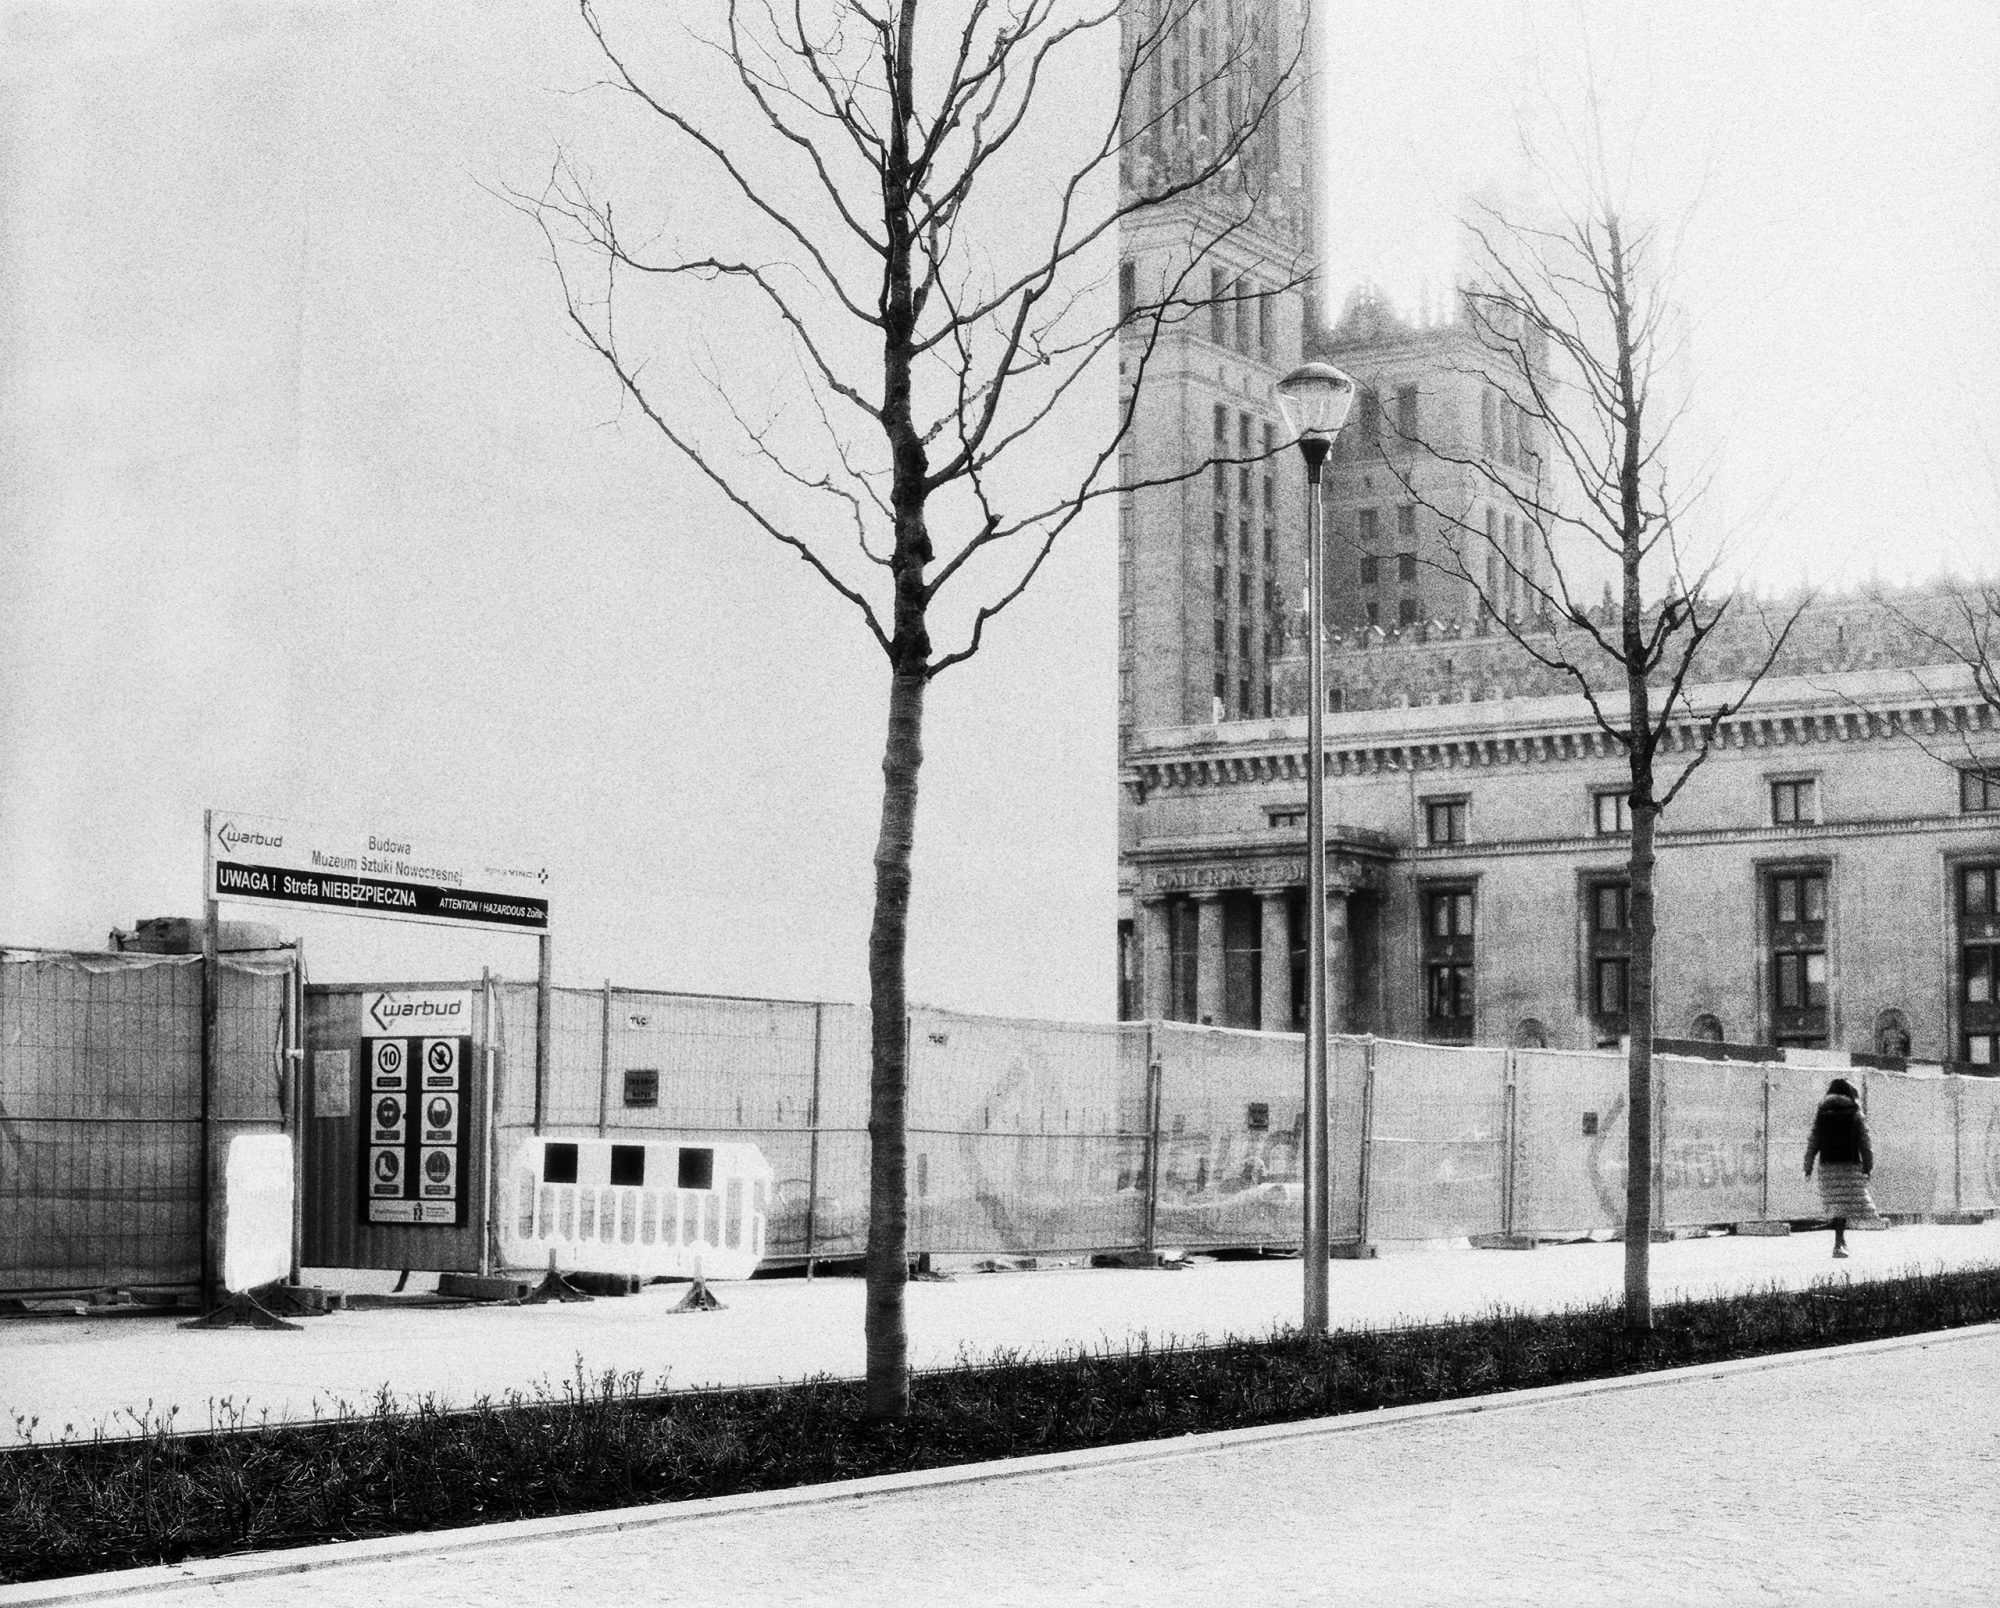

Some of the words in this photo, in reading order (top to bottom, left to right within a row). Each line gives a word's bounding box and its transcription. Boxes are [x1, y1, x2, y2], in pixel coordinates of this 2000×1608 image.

[227, 831, 283, 848] warbud
[368, 835, 411, 855] Budowa
[312, 850, 357, 870] Muzeum
[361, 857, 393, 874] Sztuki
[396, 861, 463, 886] Nowoczesnej
[508, 869, 536, 878] VINCI
[219, 868, 269, 891] UWAGA
[283, 876, 319, 897] Strefa
[321, 880, 417, 907] NIEBEZPIECZNA
[439, 898, 478, 912] ATTENTION
[483, 903, 526, 917] HAZARDOUS
[383, 1000, 461, 1016] warbud
[383, 1050, 397, 1066] 10
